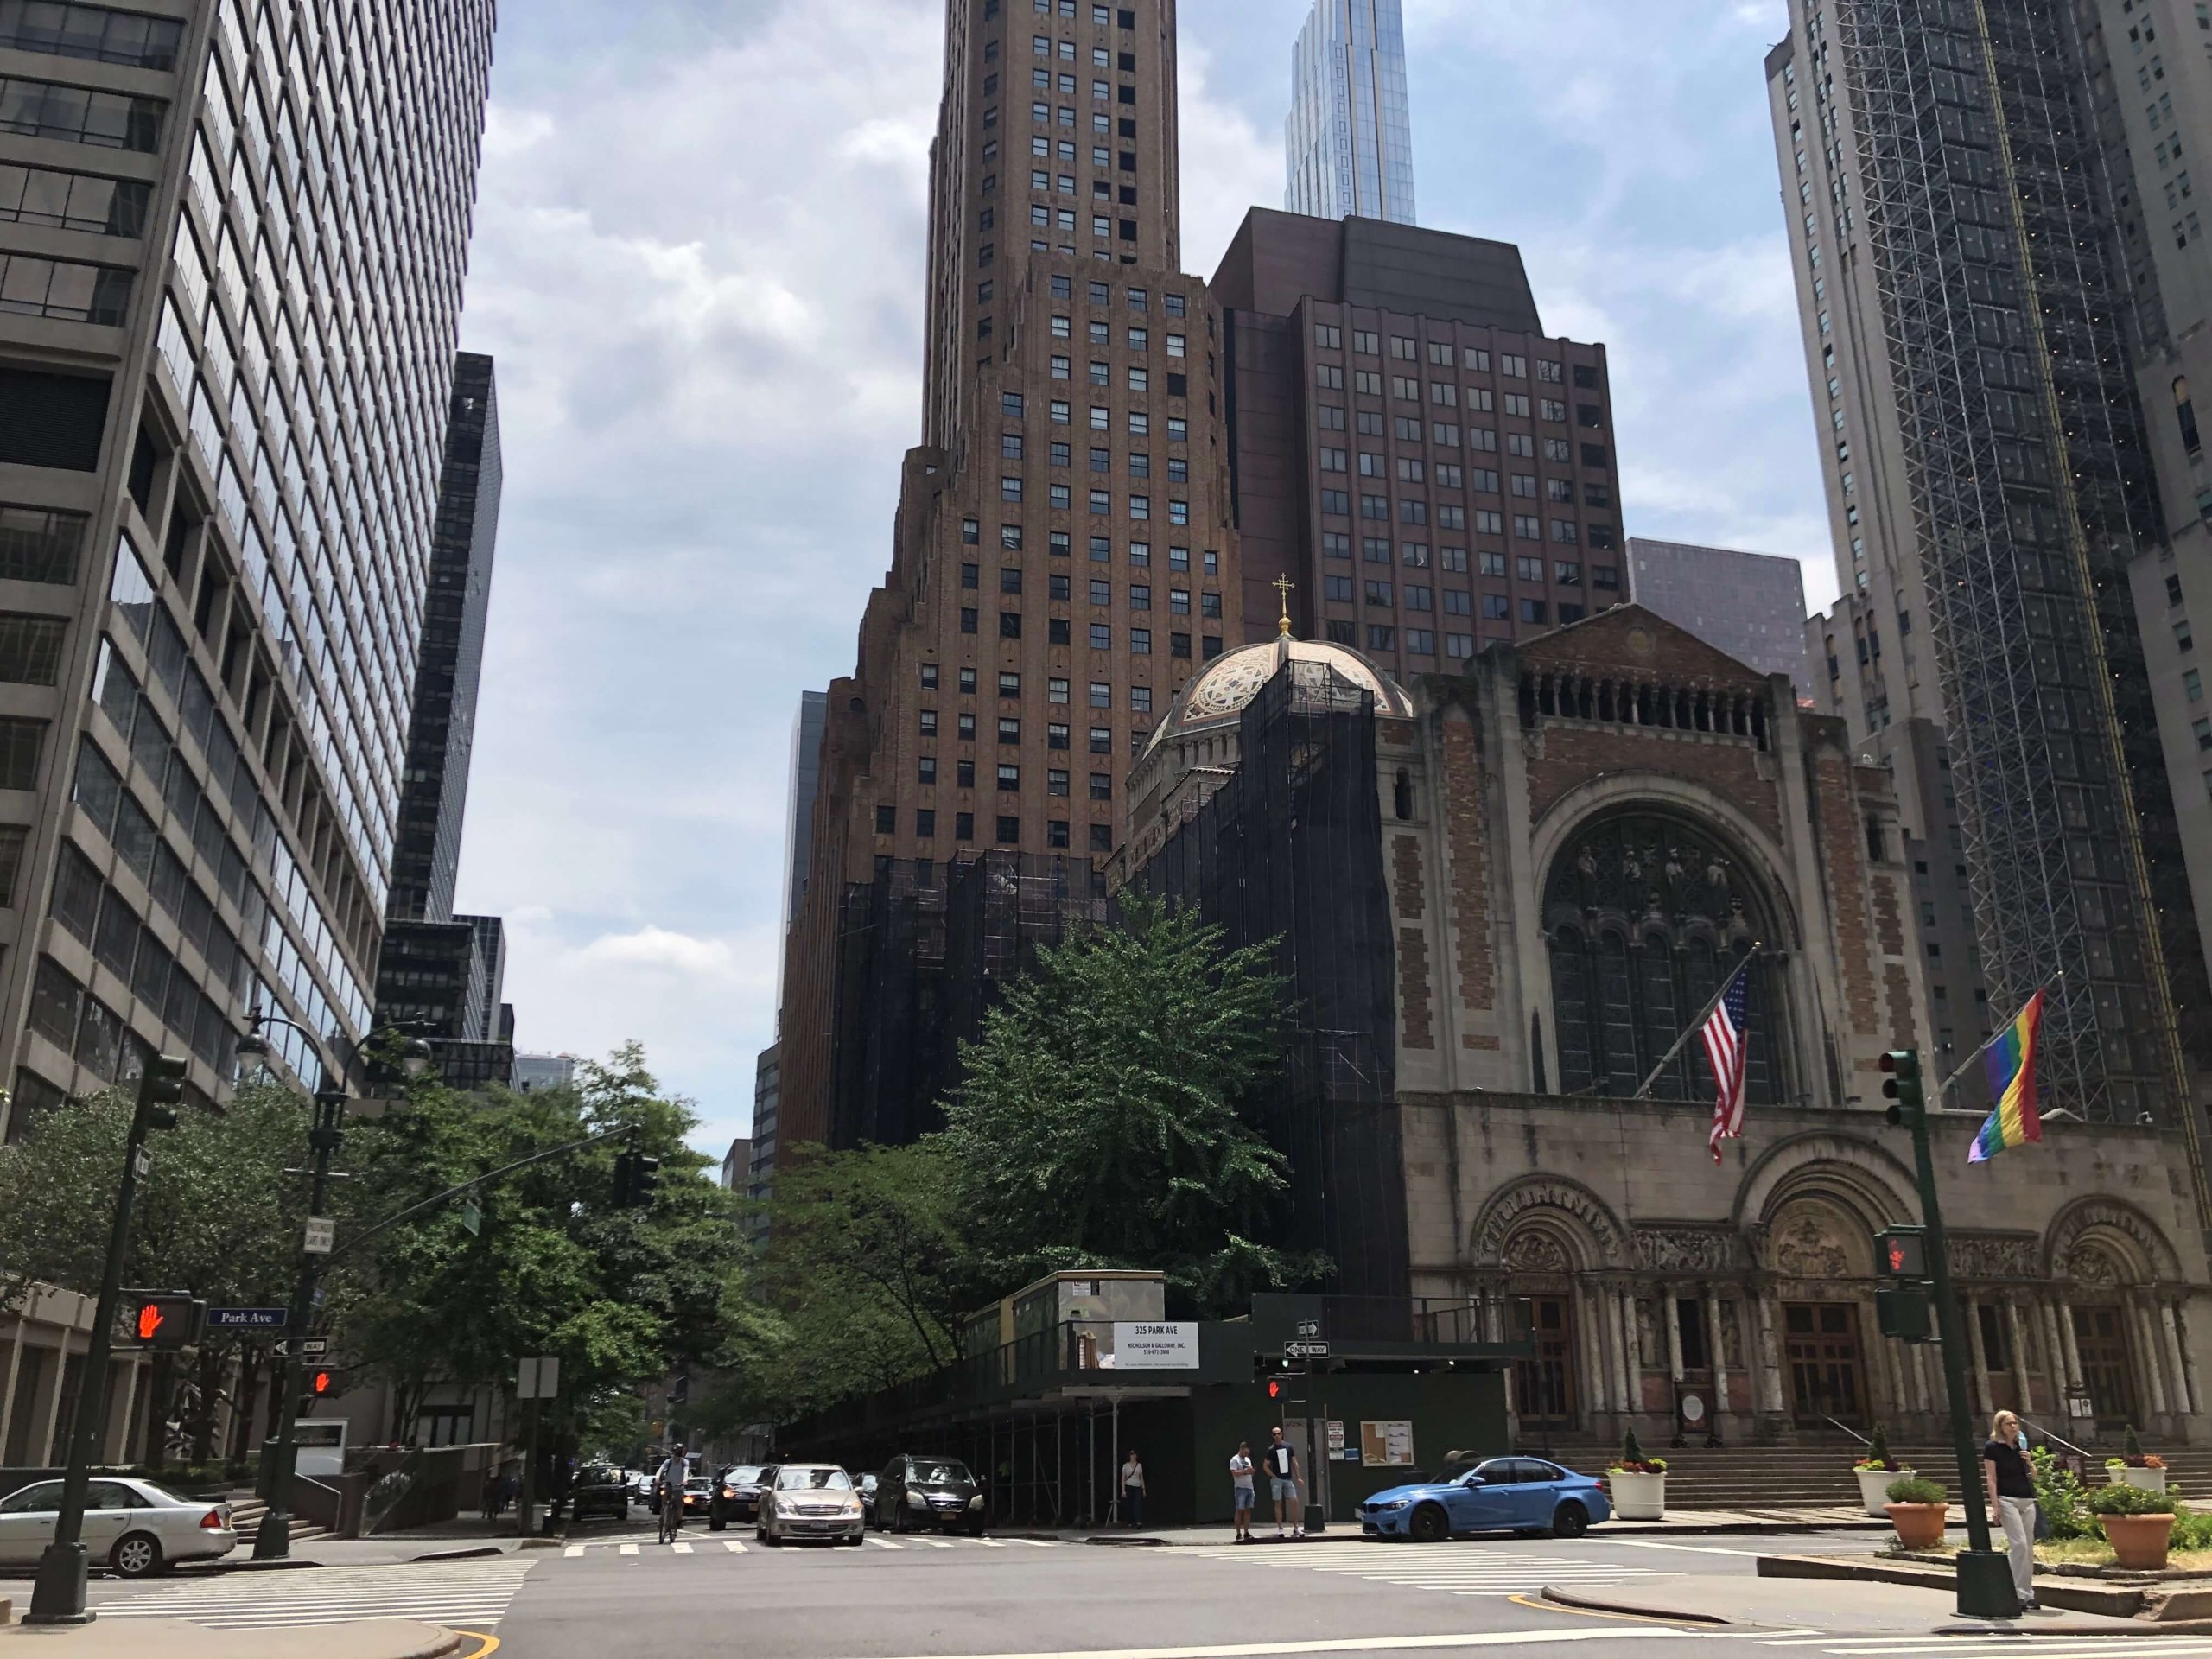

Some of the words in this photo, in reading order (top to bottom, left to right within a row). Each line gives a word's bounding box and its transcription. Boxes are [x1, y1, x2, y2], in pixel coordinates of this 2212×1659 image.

[221, 1313, 246, 1323] Park
[250, 1313, 272, 1323] Ave
[1135, 1325, 1147, 1335] 325
[1148, 1325, 1165, 1335] PARK
[1166, 1325, 1178, 1335] AVE
